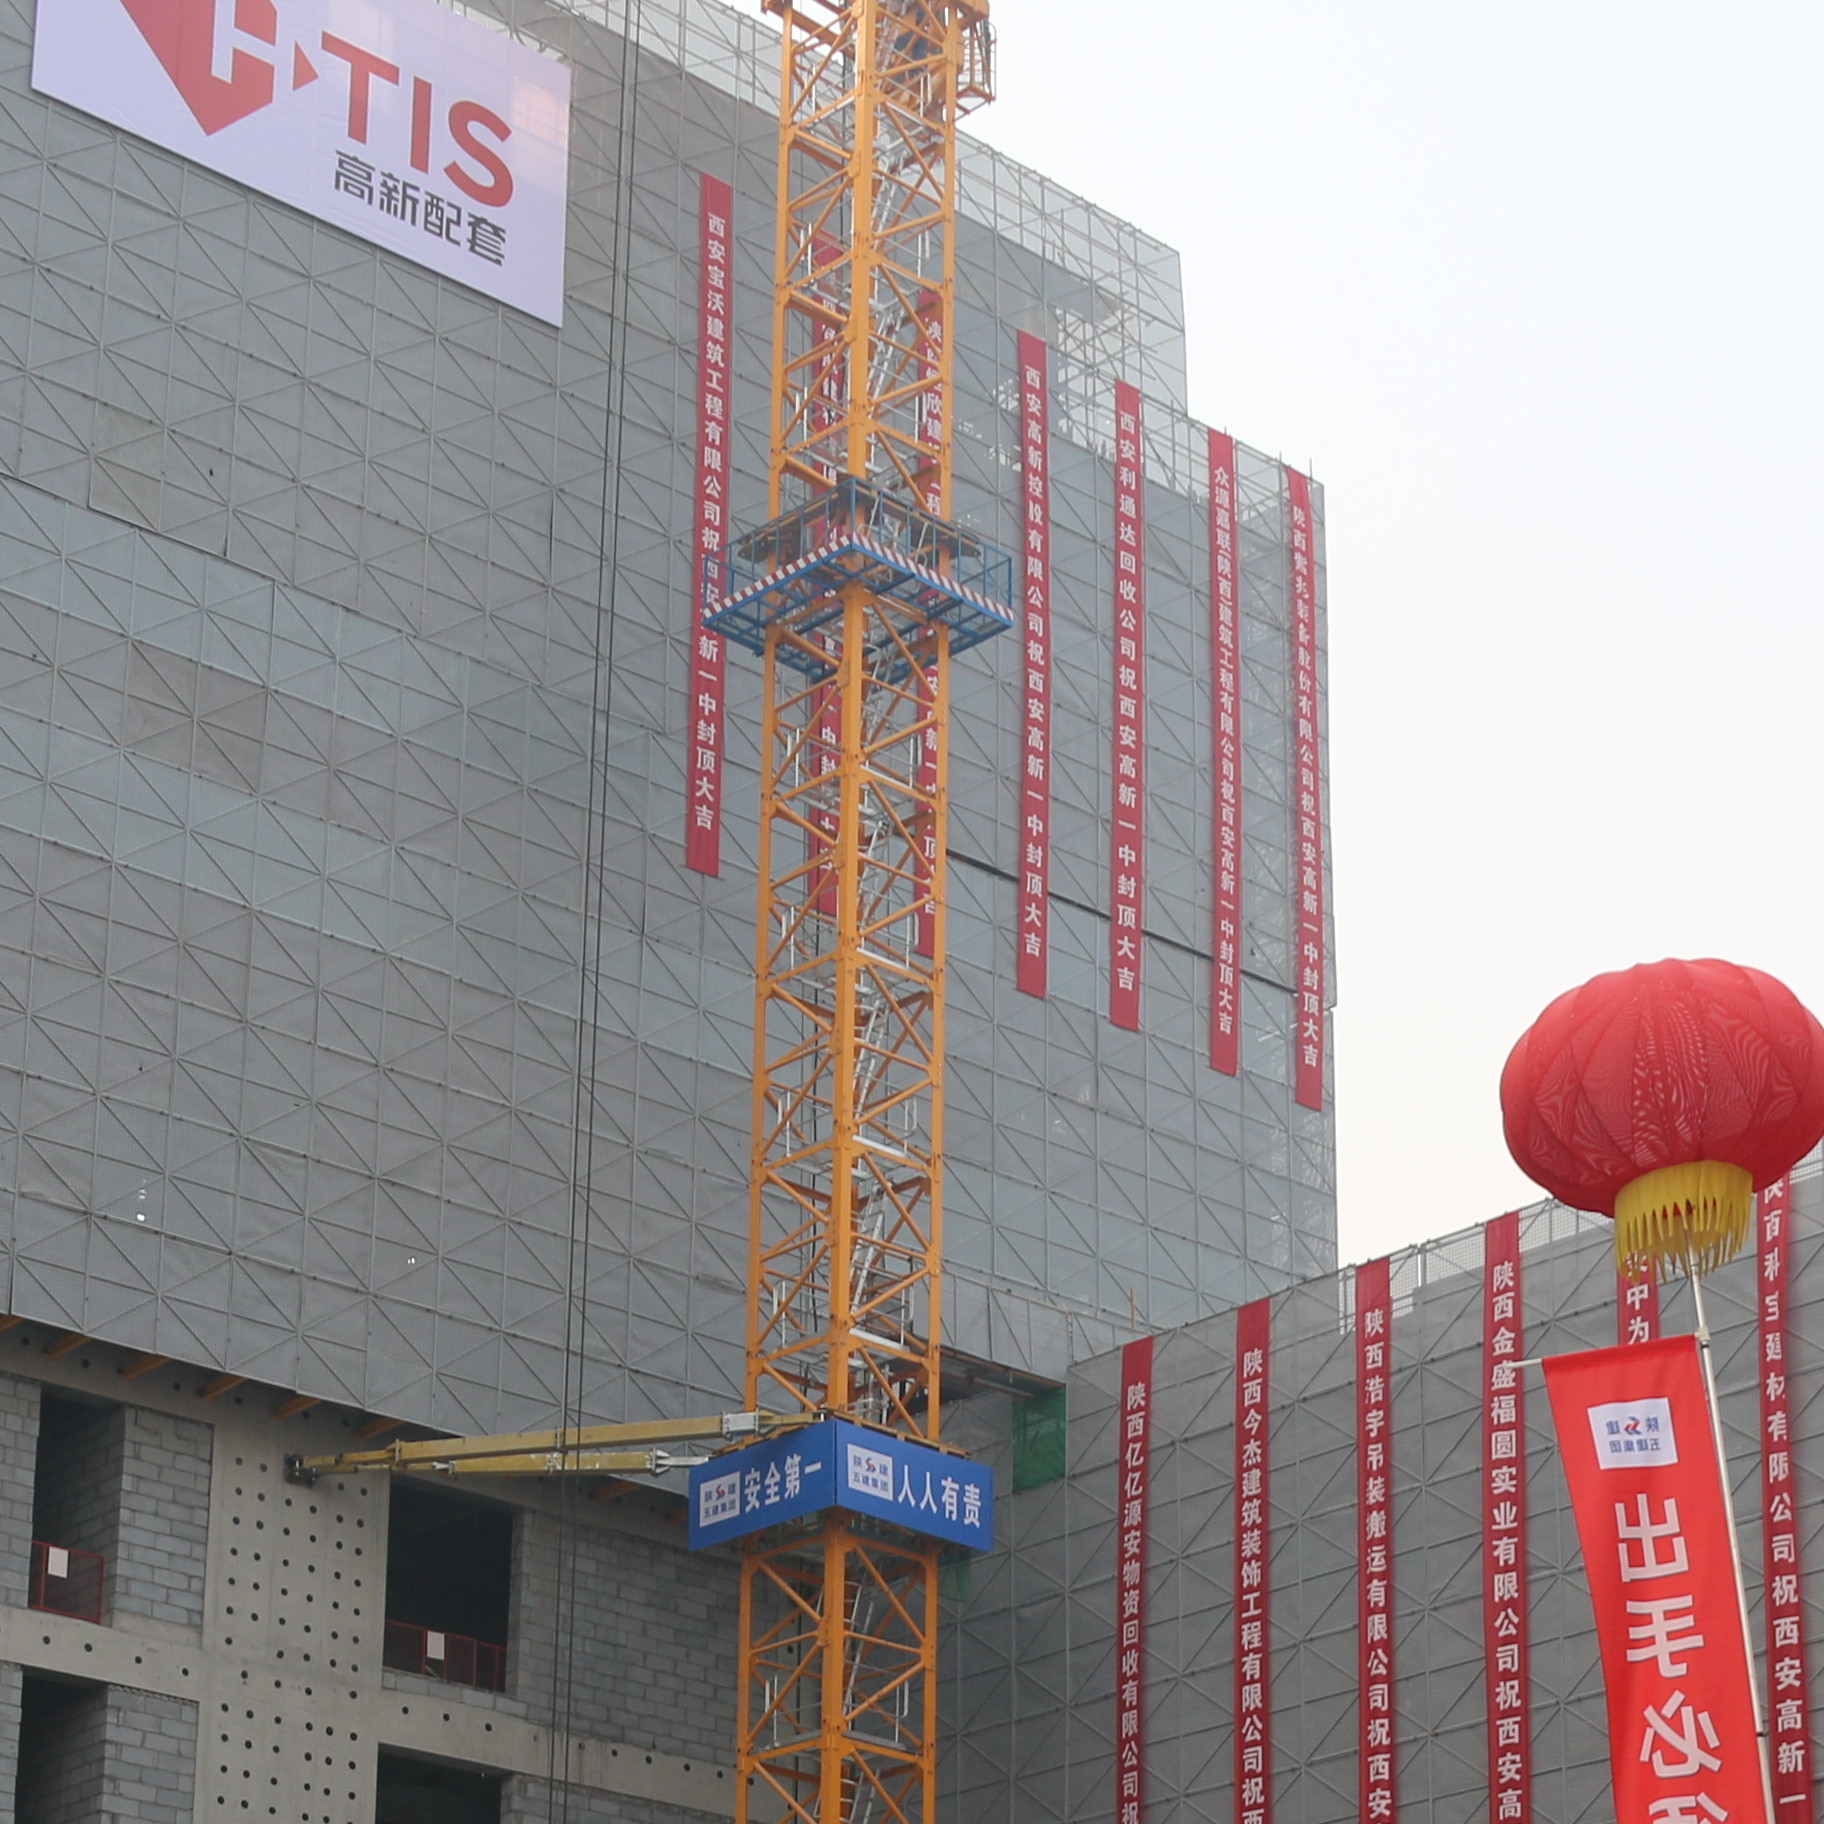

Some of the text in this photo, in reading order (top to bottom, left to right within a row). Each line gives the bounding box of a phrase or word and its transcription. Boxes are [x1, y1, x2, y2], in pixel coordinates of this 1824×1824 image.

[334, 148, 507, 267] 高新配套
[694, 213, 725, 831] 西安宝沃建筑工程有限公司祝西安新一中封顶大吉
[1024, 366, 1046, 957] 西安高新控股有限公司祝西安高新一中封顶大吉
[1117, 409, 1138, 991] 西安利通达回收公司祝西安高新一中封顶大吉
[744, 1452, 822, 1514] 安全第一
[897, 1463, 982, 1529] 人人有责
